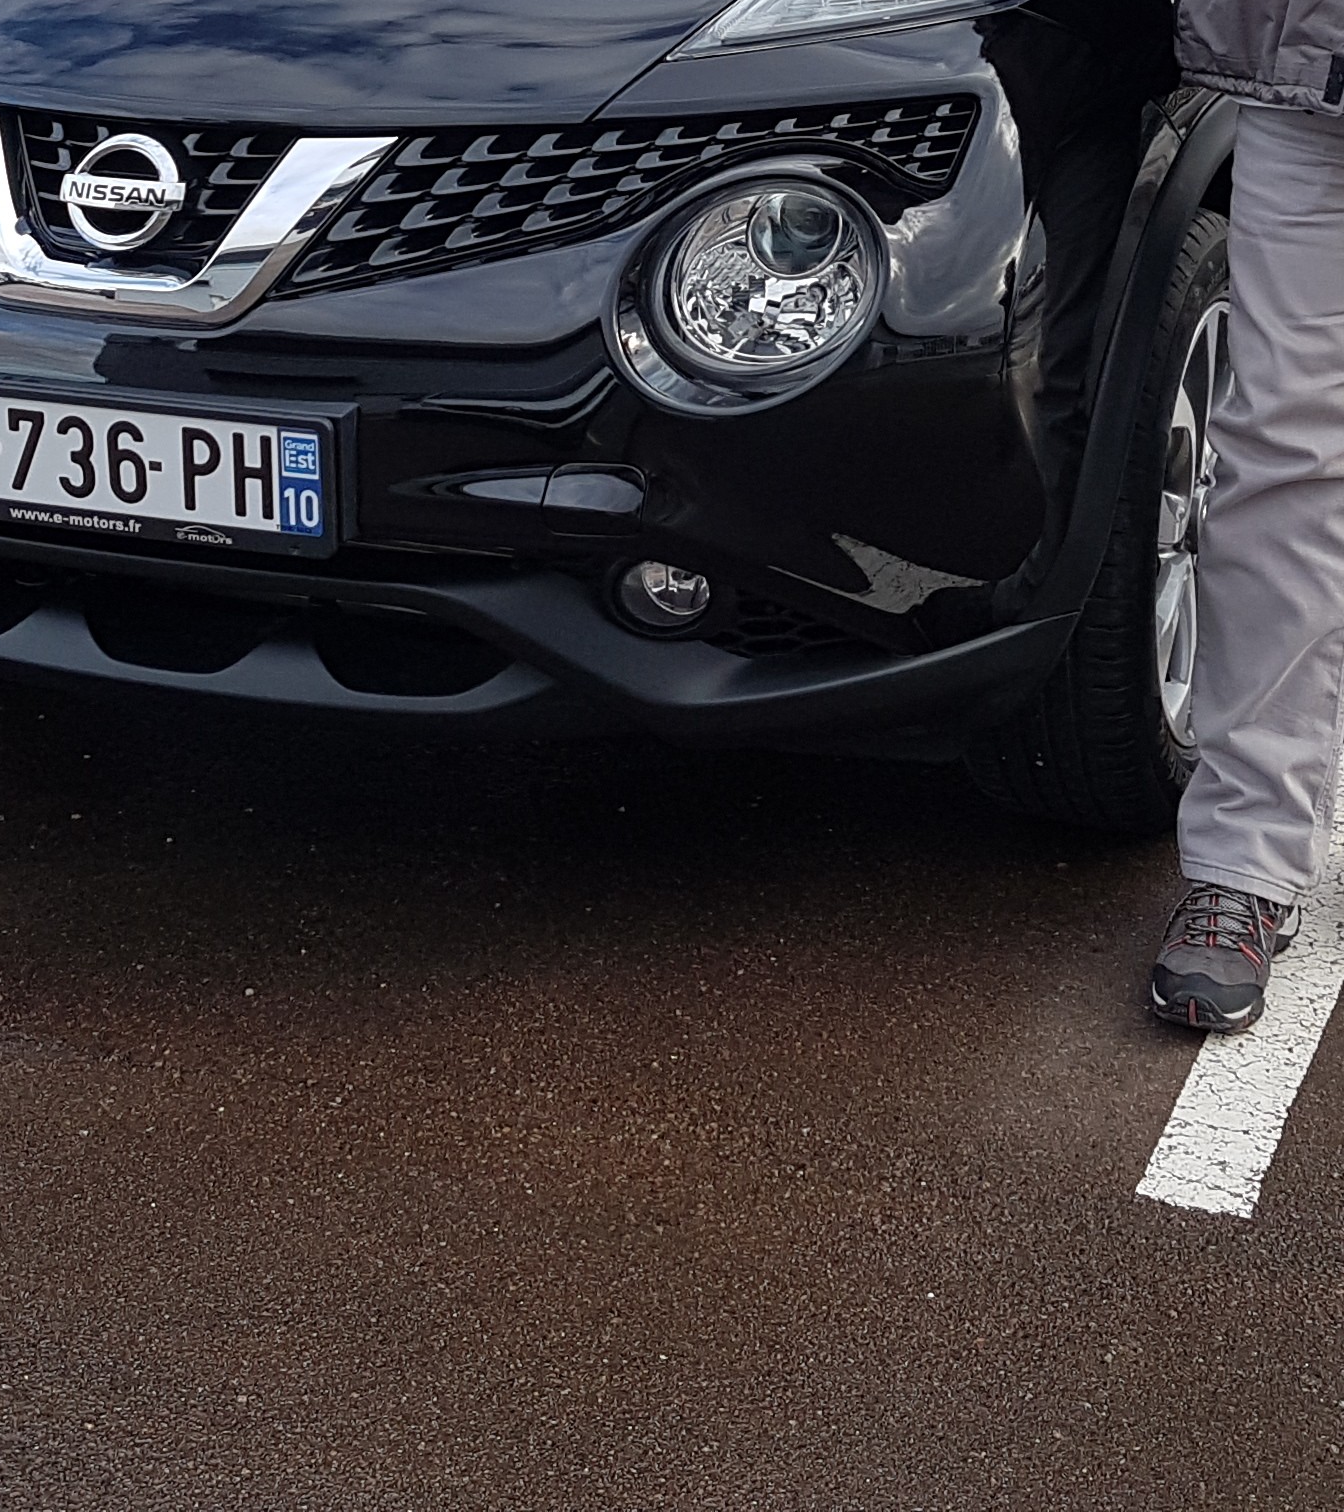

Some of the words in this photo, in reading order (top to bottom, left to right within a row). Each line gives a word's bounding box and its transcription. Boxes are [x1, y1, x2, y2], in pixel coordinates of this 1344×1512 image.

[68, 181, 167, 205] NISSAN
[284, 439, 315, 452] Grand
[285, 449, 316, 470] Est
[283, 487, 320, 528] 10
[9, 507, 142, 534] www.e-motors.fr
